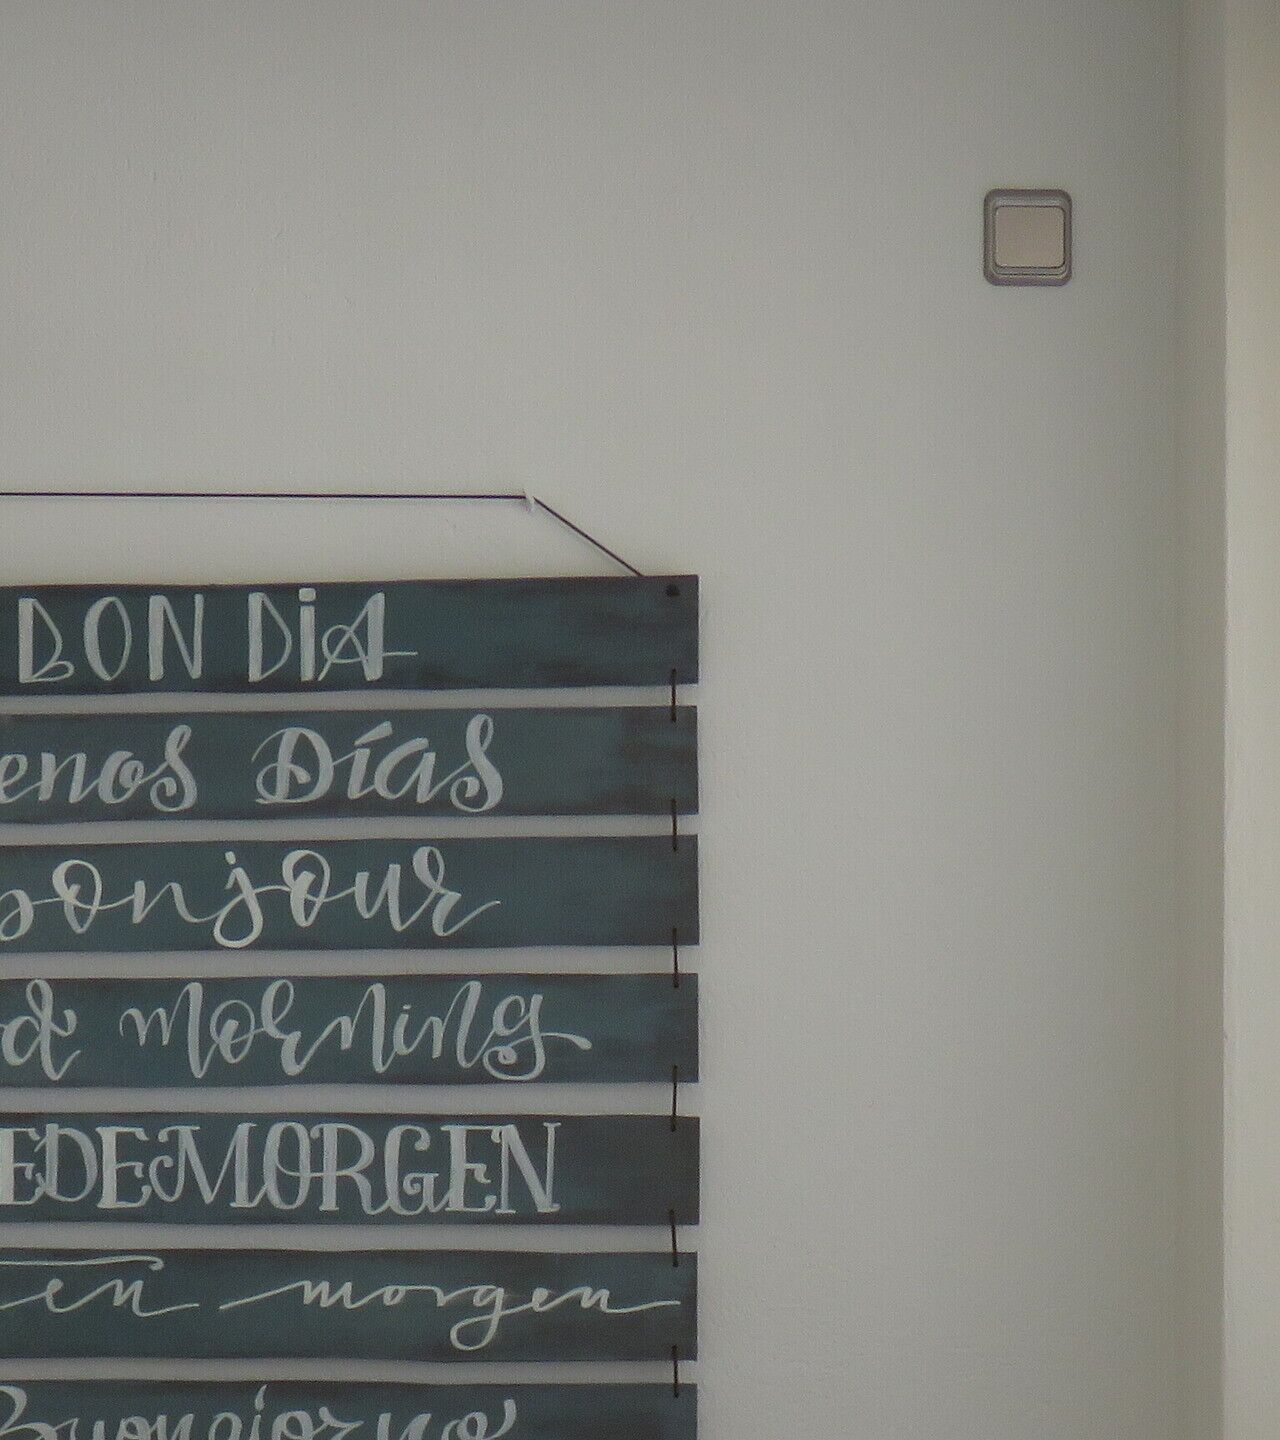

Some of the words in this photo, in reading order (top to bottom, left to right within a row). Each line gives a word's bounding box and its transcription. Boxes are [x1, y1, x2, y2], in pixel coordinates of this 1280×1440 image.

[253, 713, 505, 812] Días
[120, 979, 592, 1080] morning
[220, 1280, 682, 1350] morgen
